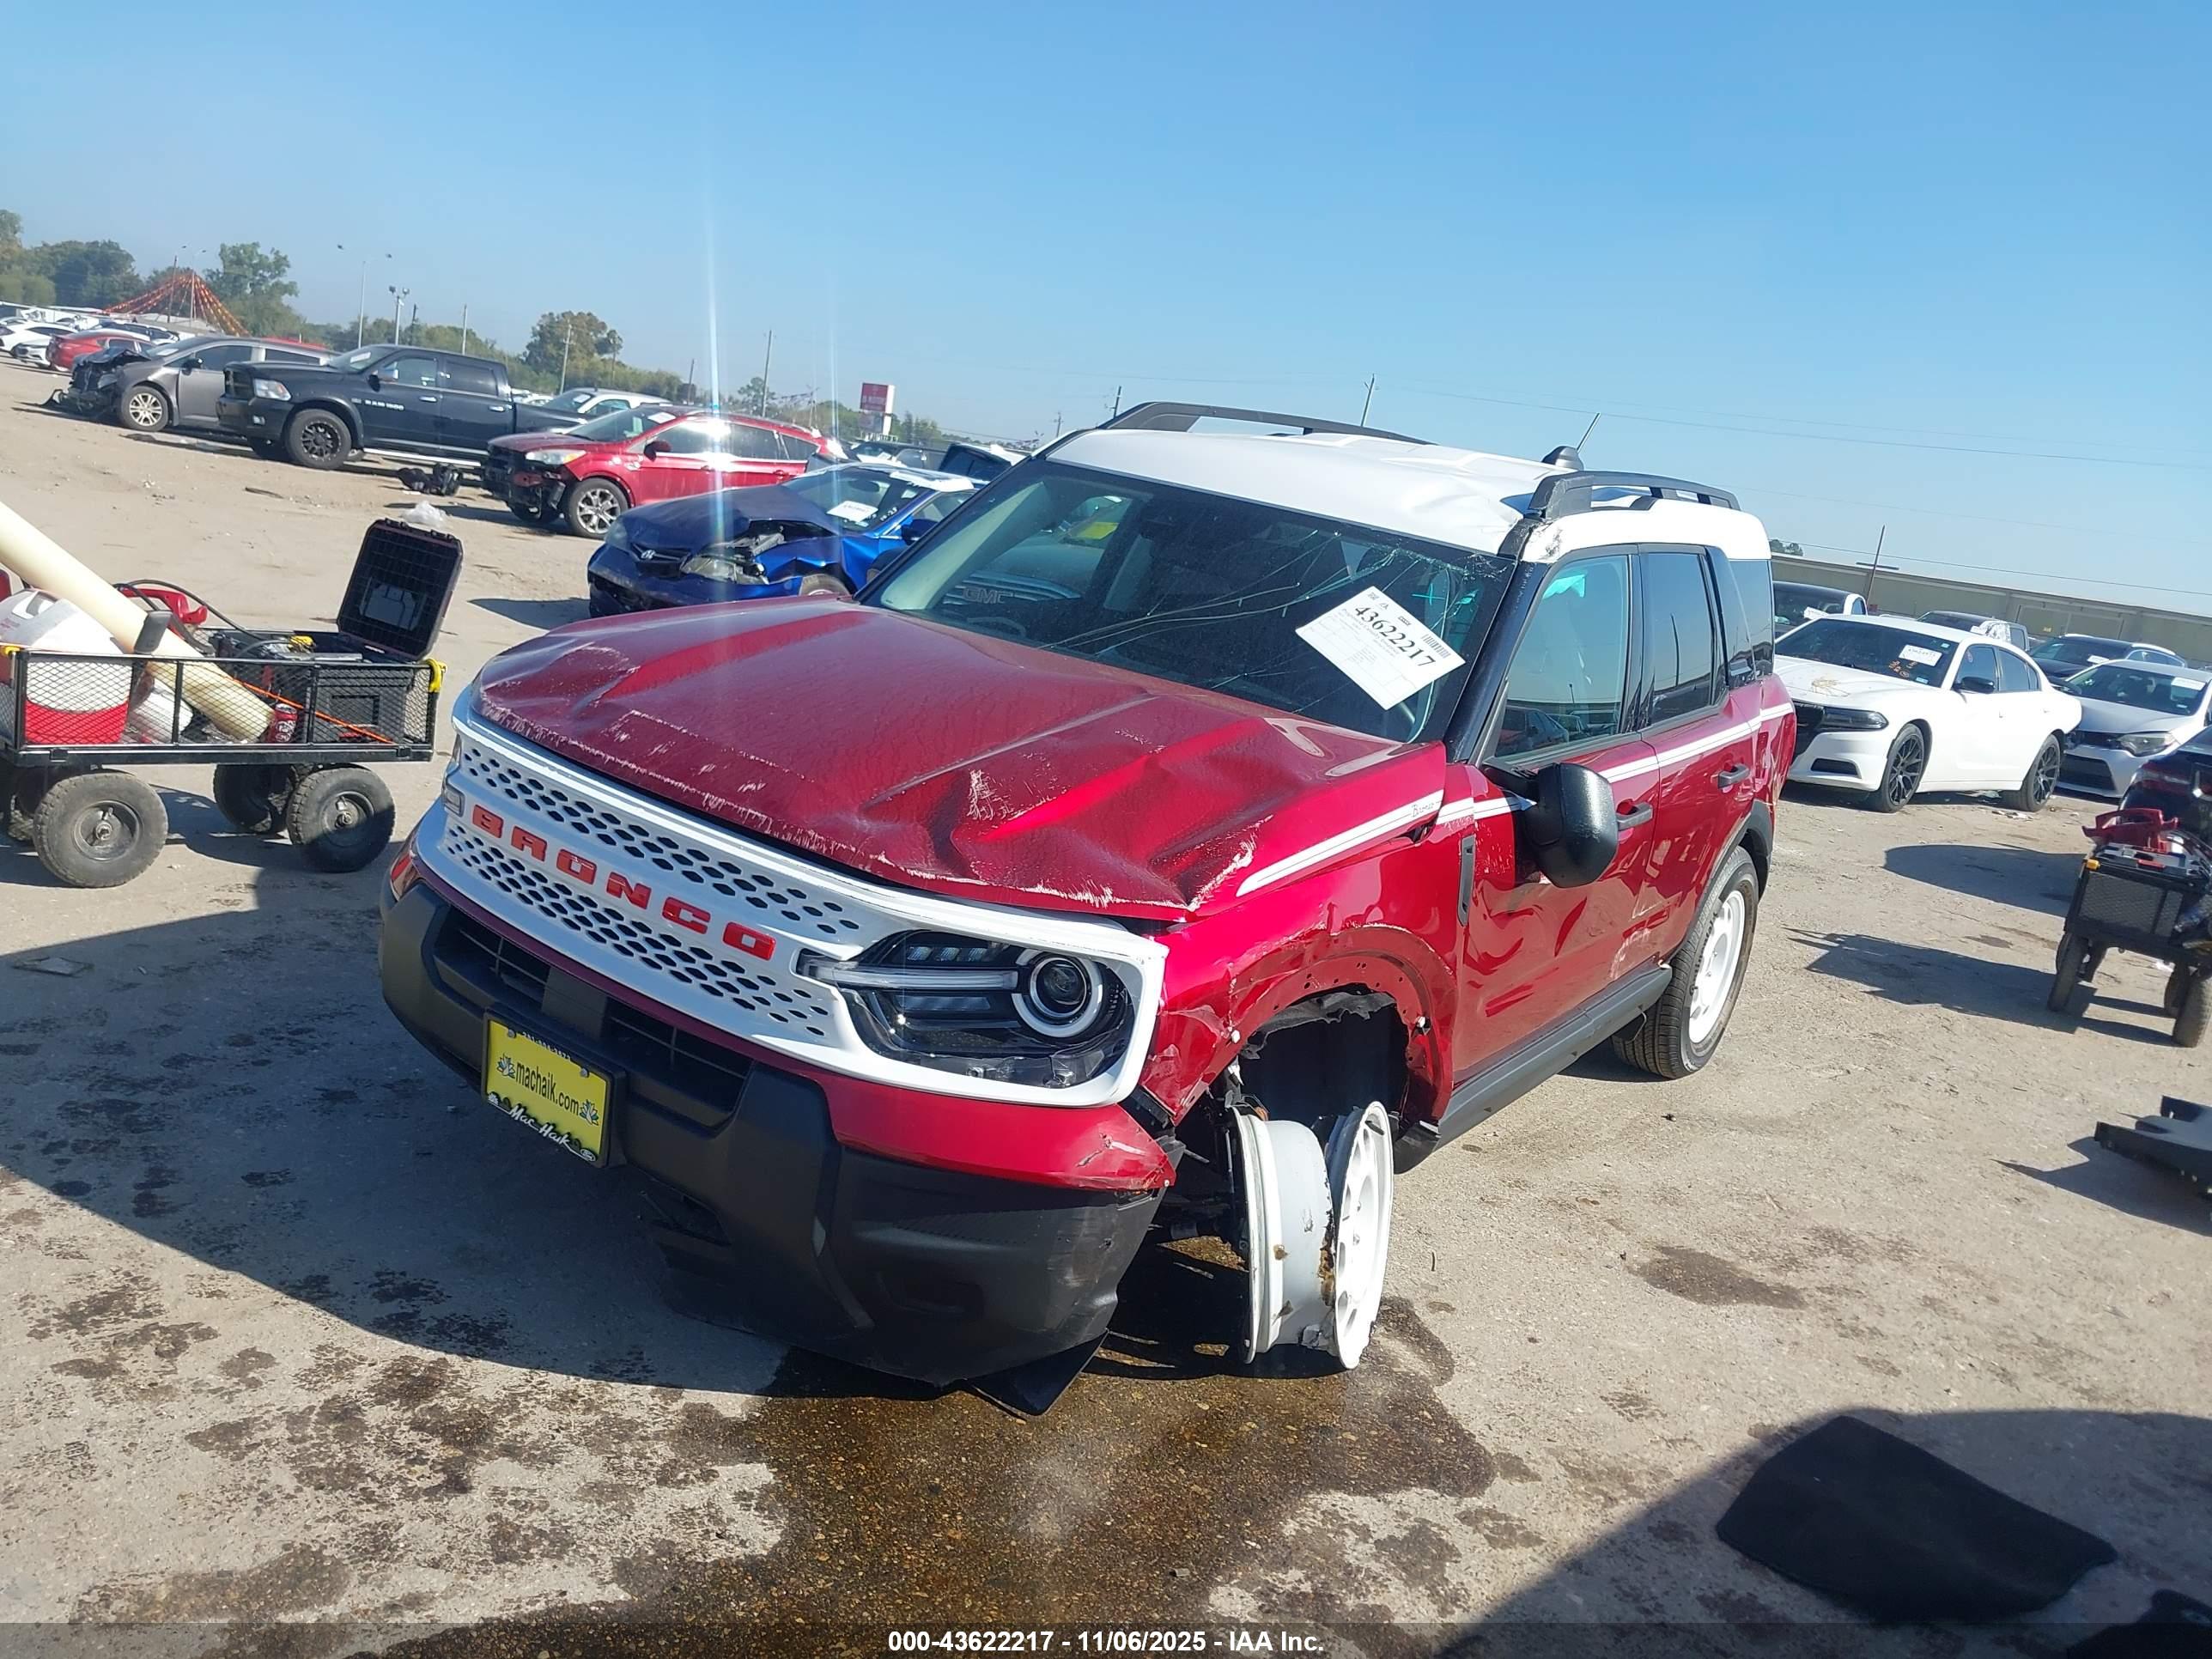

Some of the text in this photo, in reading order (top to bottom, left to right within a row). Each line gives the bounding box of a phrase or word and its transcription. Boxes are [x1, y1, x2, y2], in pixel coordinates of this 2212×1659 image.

[963, 586, 1013, 604] GMC
[1354, 605, 1436, 667] 43622217
[472, 804, 776, 961] BRONCO
[516, 1061, 580, 1115] machaik.com
[509, 1104, 571, 1147] Mac Haik
